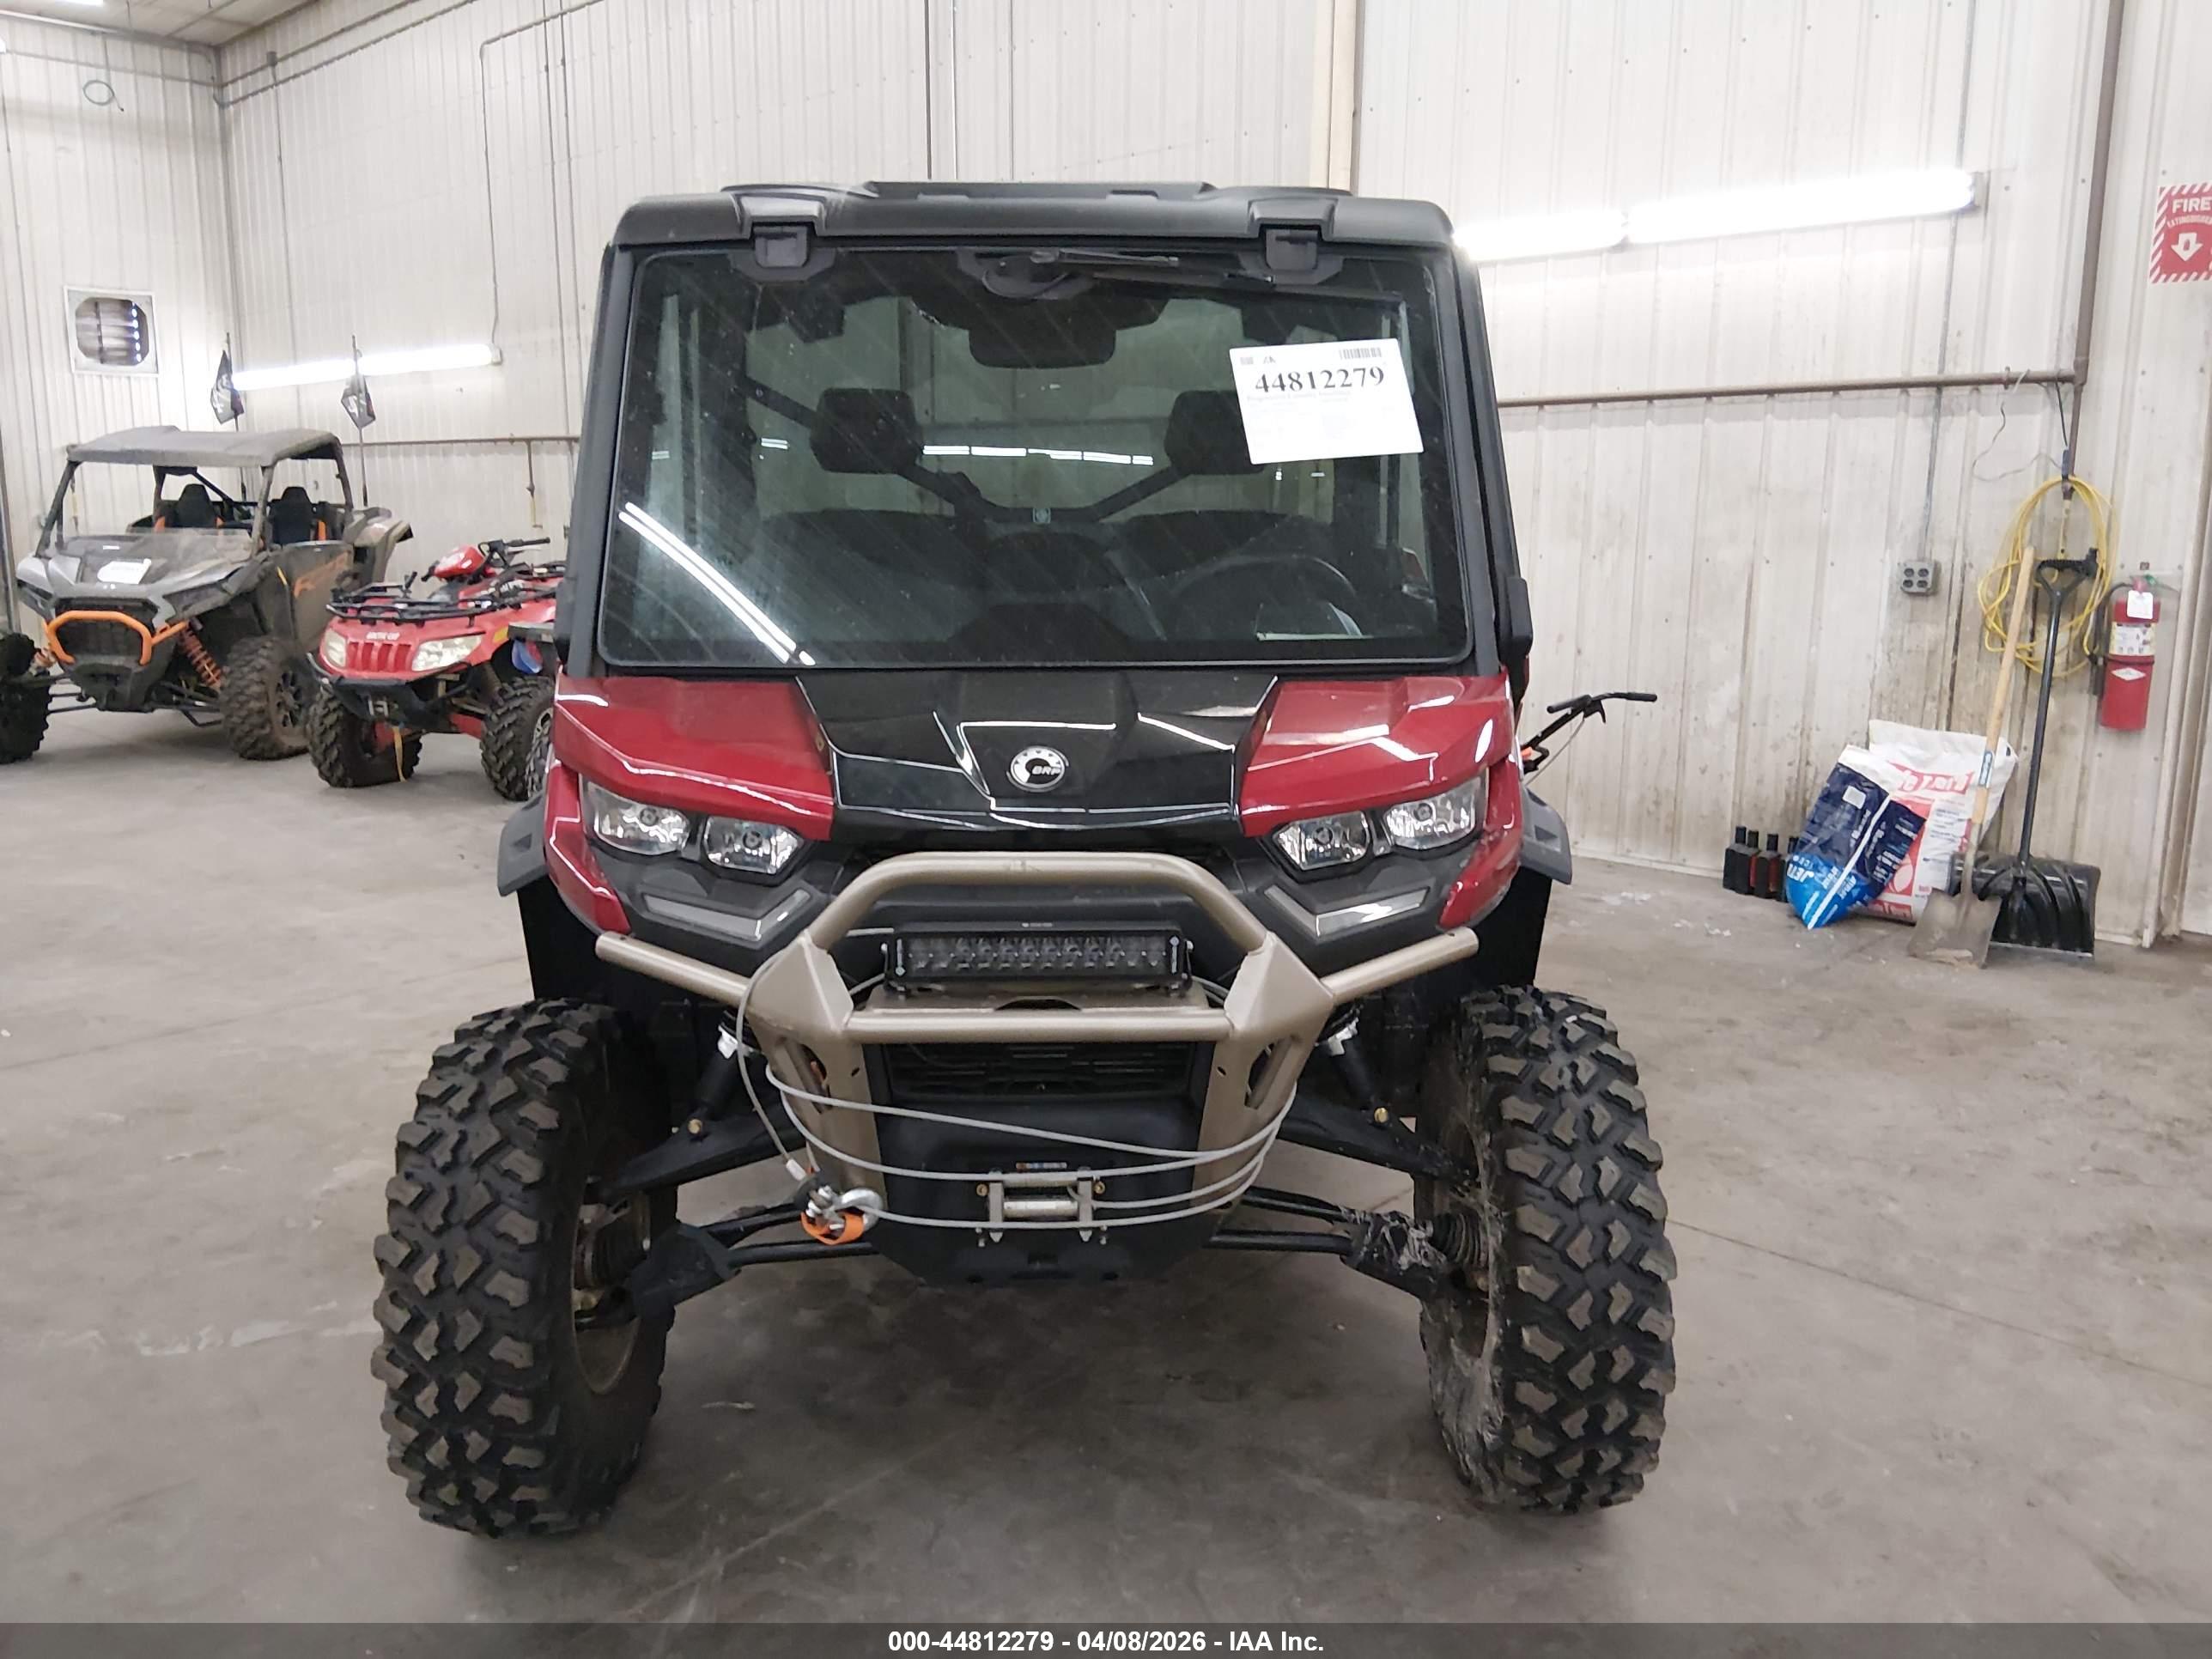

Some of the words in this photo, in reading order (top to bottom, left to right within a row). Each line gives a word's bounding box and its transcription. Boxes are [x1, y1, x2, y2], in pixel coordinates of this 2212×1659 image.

[2172, 196, 2212, 214] FIRE
[1255, 366, 1385, 392] 44812279
[1031, 765, 1062, 775] BRP
